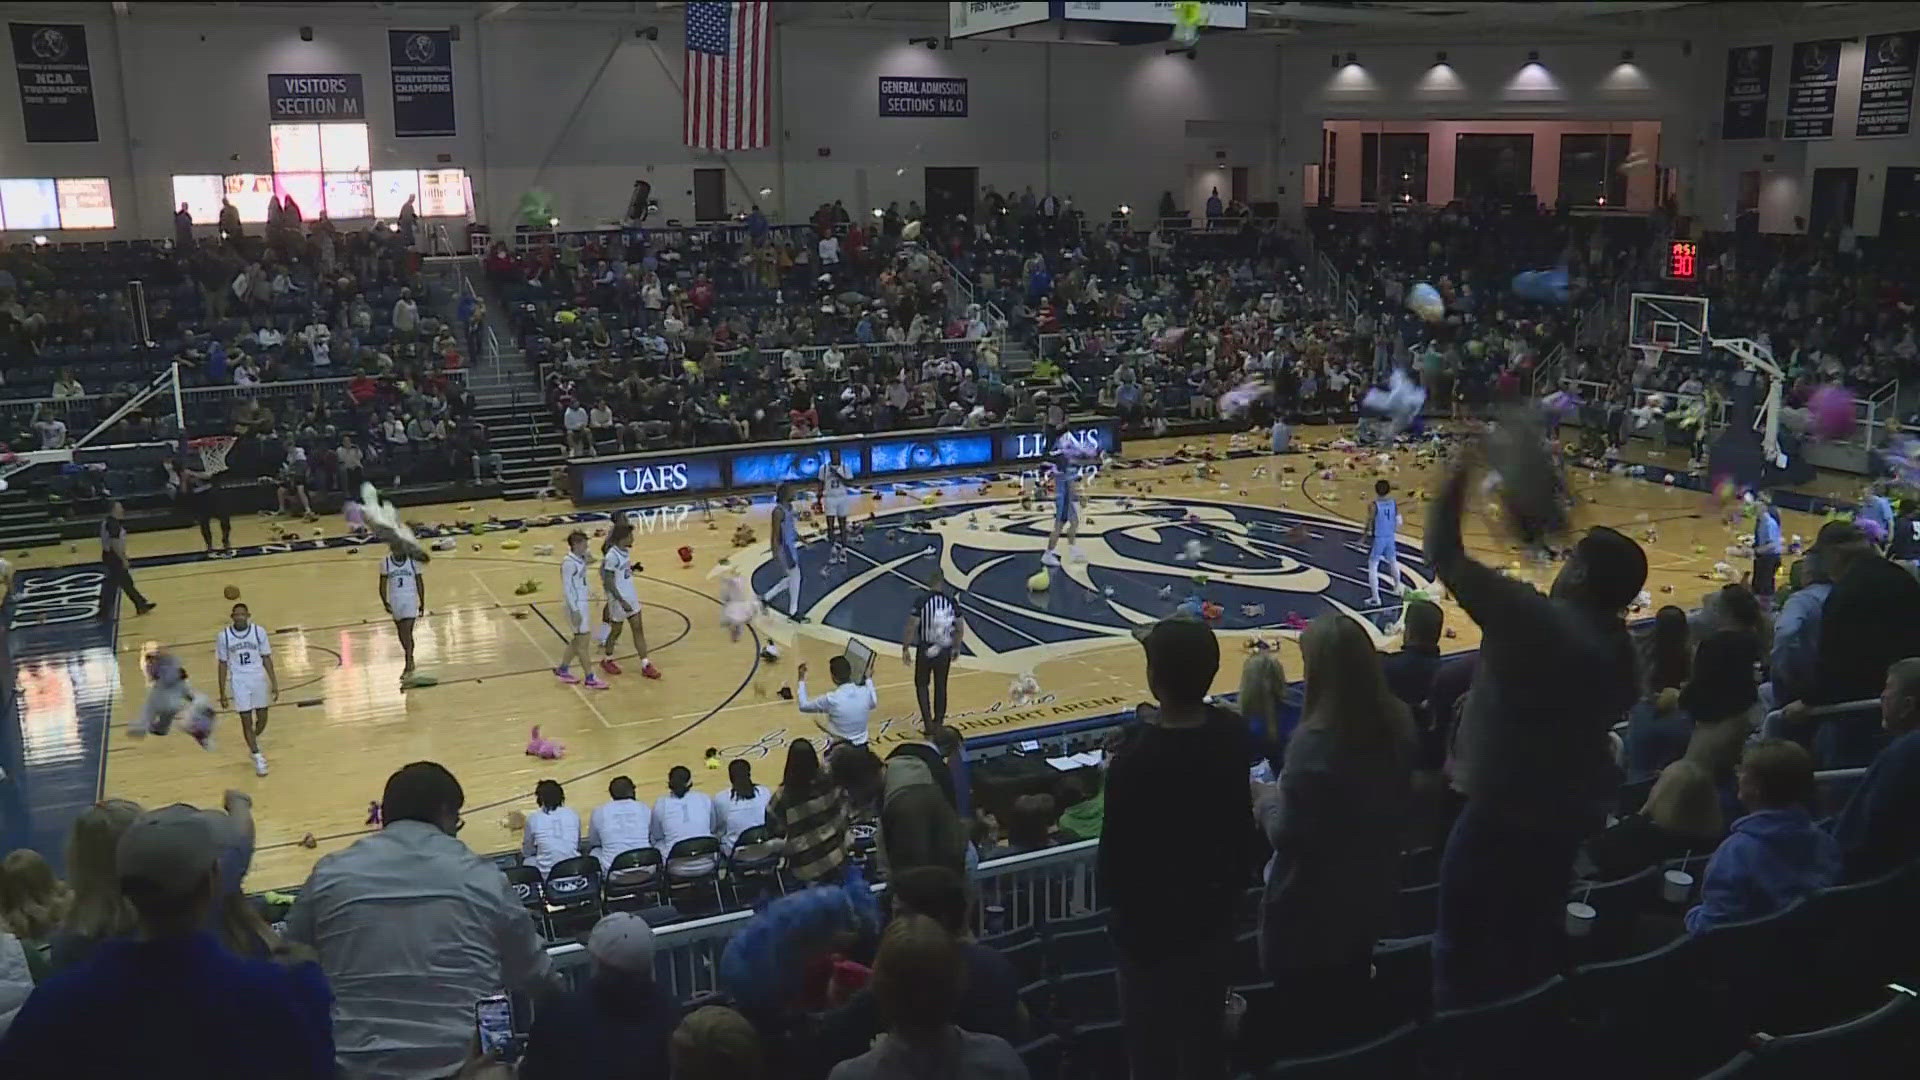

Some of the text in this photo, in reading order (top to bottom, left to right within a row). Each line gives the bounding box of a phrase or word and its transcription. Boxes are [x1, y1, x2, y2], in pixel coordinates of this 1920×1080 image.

[35, 73, 74, 84] NCAA
[285, 78, 347, 94] VISITORS
[395, 84, 450, 93] CHAMPIONS
[881, 81, 966, 95] GENERAL ADMISSION
[277, 97, 358, 114] SECTION M
[888, 98, 935, 112] SECTIONS
[1674, 255, 1692, 276] 30
[1016, 428, 1099, 458] LINS
[617, 463, 688, 495] UAFS
[1383, 508, 1390, 521] 4
[397, 577, 404, 588] 3
[9, 572, 106, 630] UAFS
[239, 651, 252, 665] 12
[1053, 696, 1127, 715] ARENA
